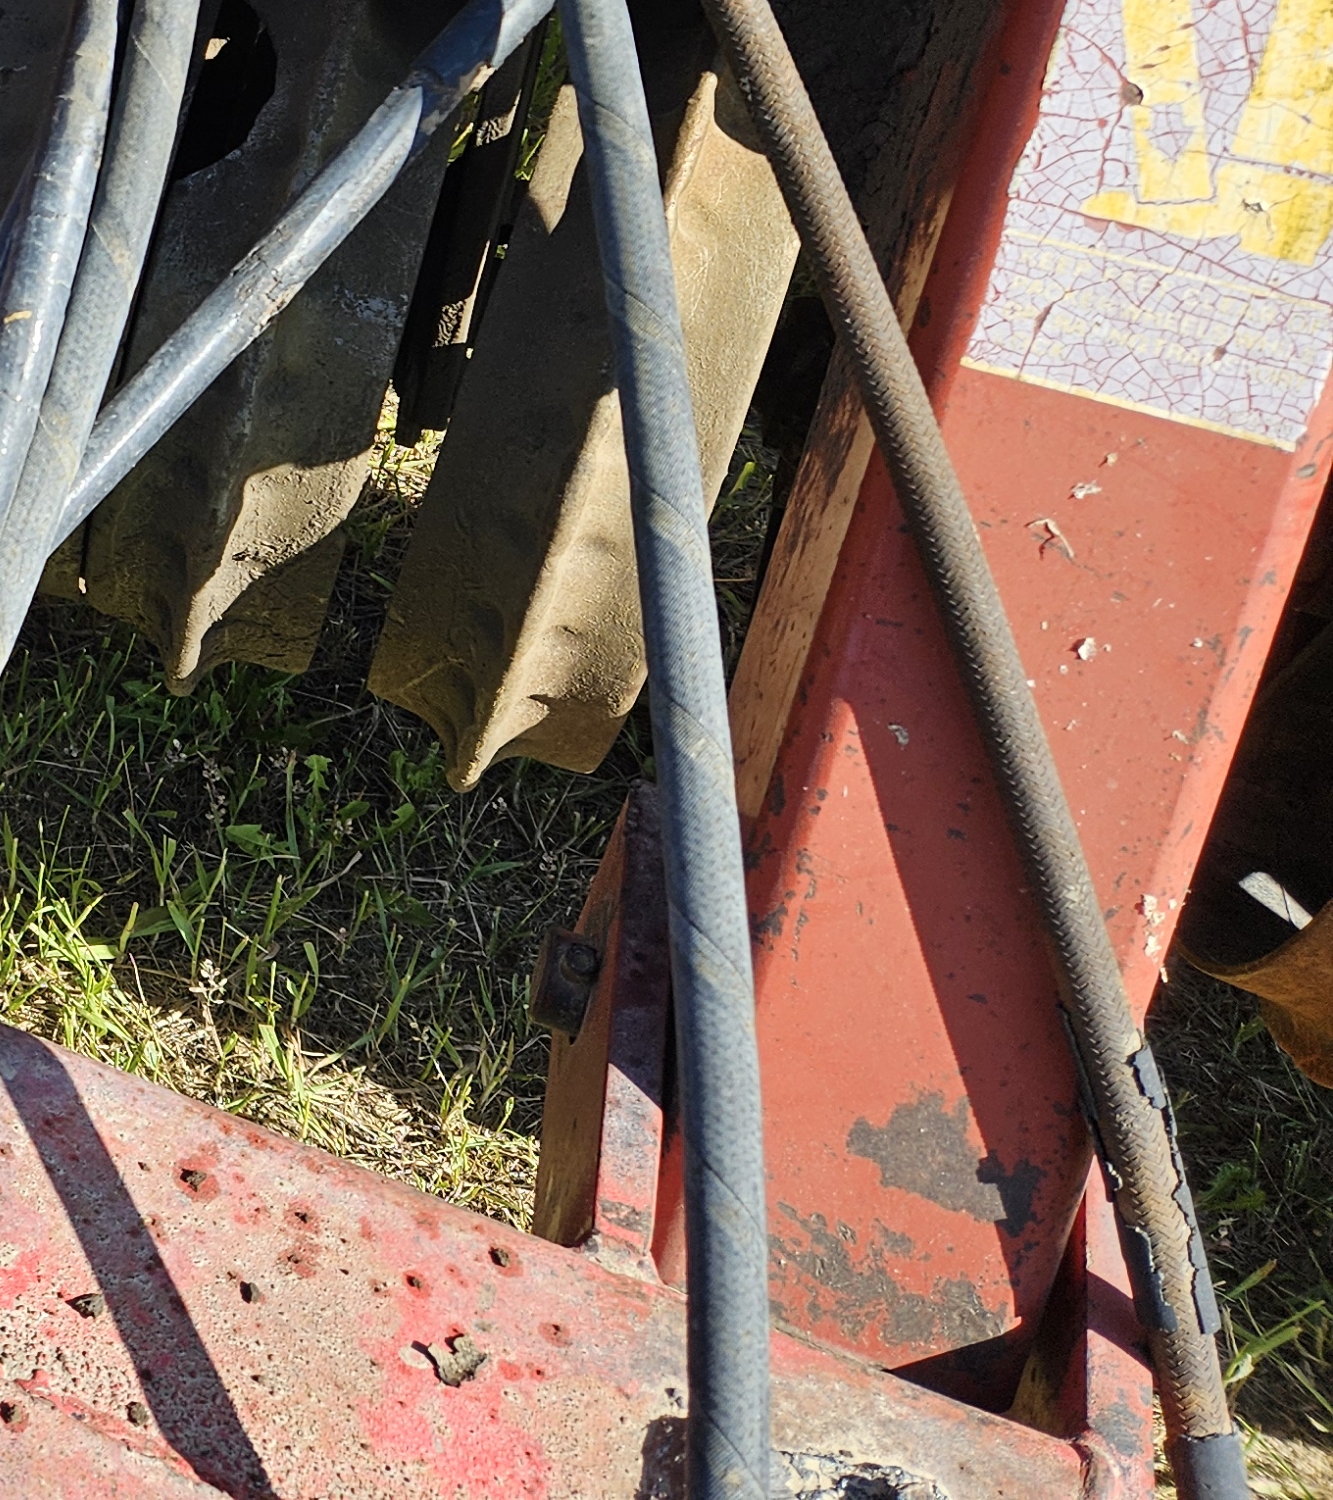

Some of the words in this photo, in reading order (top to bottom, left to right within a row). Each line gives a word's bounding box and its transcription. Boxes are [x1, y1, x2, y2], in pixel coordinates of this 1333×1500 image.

[1016, 246, 1094, 281] KEEP
[1099, 265, 1173, 300] FEET
[1179, 285, 1278, 326] CLEAR
[999, 298, 1152, 353] OPRANG
[1118, 300, 1230, 344] WHEELS
